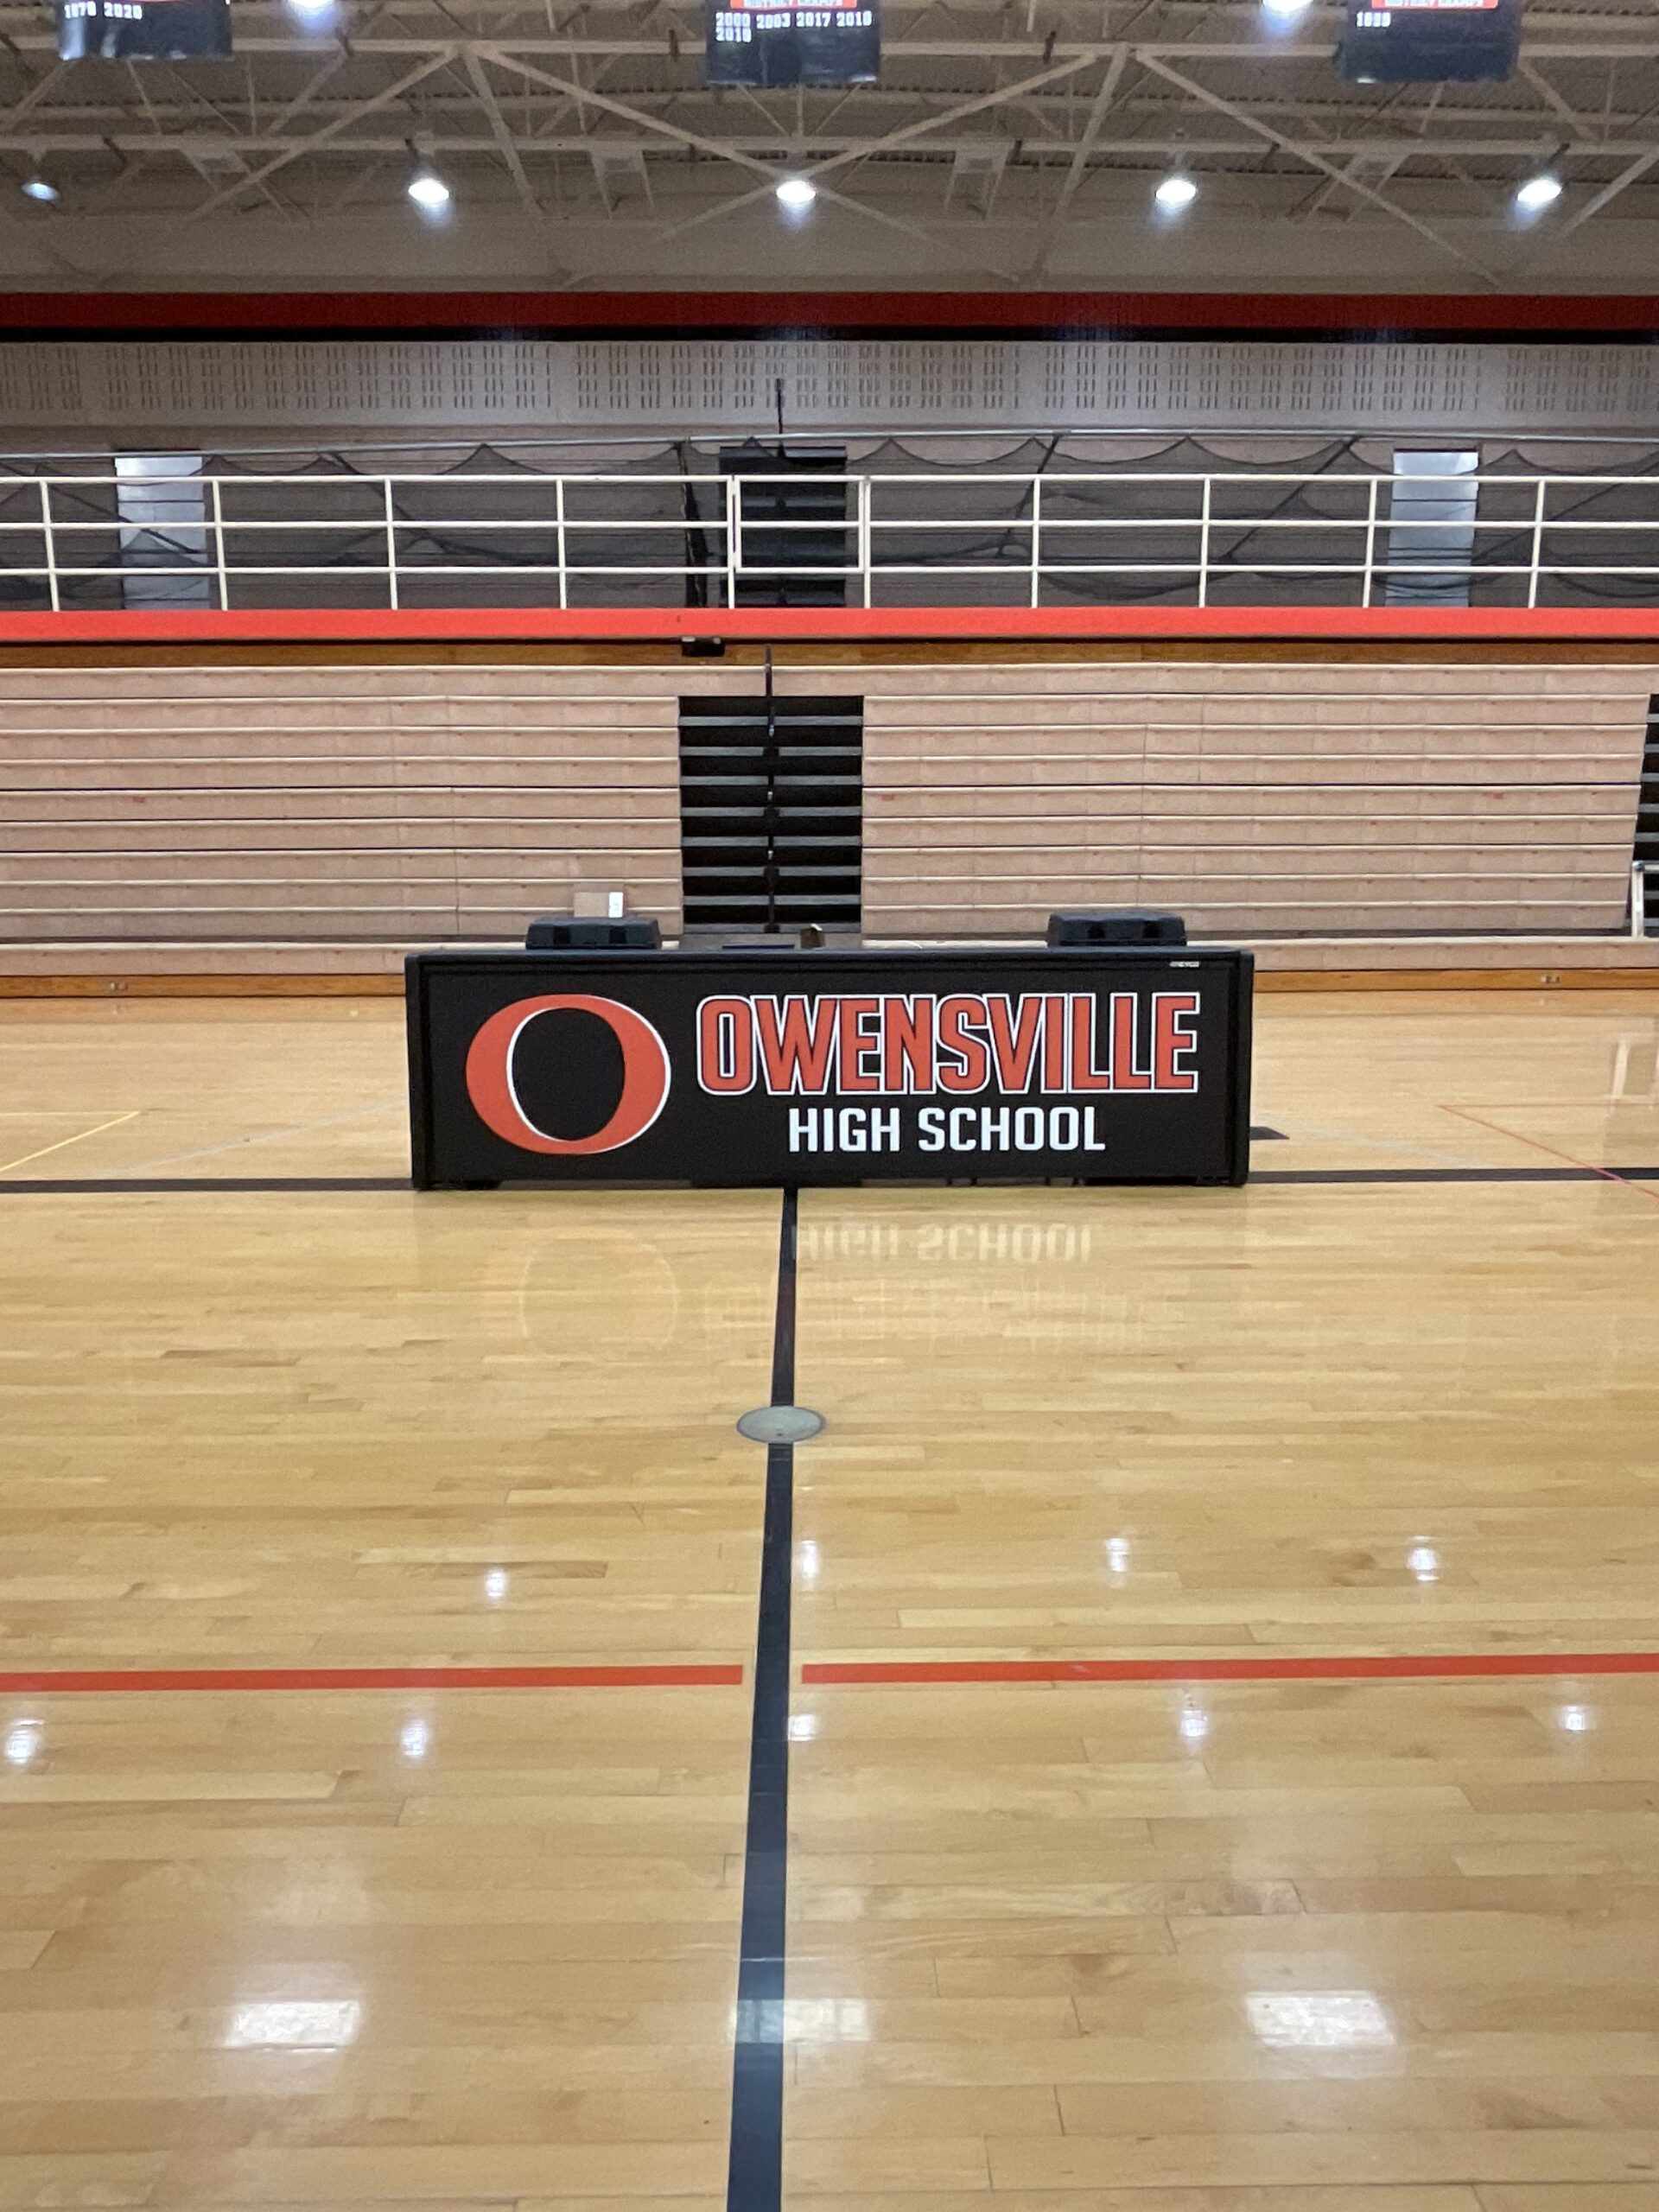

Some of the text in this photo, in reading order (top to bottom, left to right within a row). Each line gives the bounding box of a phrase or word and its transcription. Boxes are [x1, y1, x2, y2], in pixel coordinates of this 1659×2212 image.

[796, 12, 831, 27] 2017
[465, 993, 671, 1154] O
[696, 991, 1200, 1096] OWENSVILLE
[789, 1106, 1105, 1153] HIGH SCHOOL
